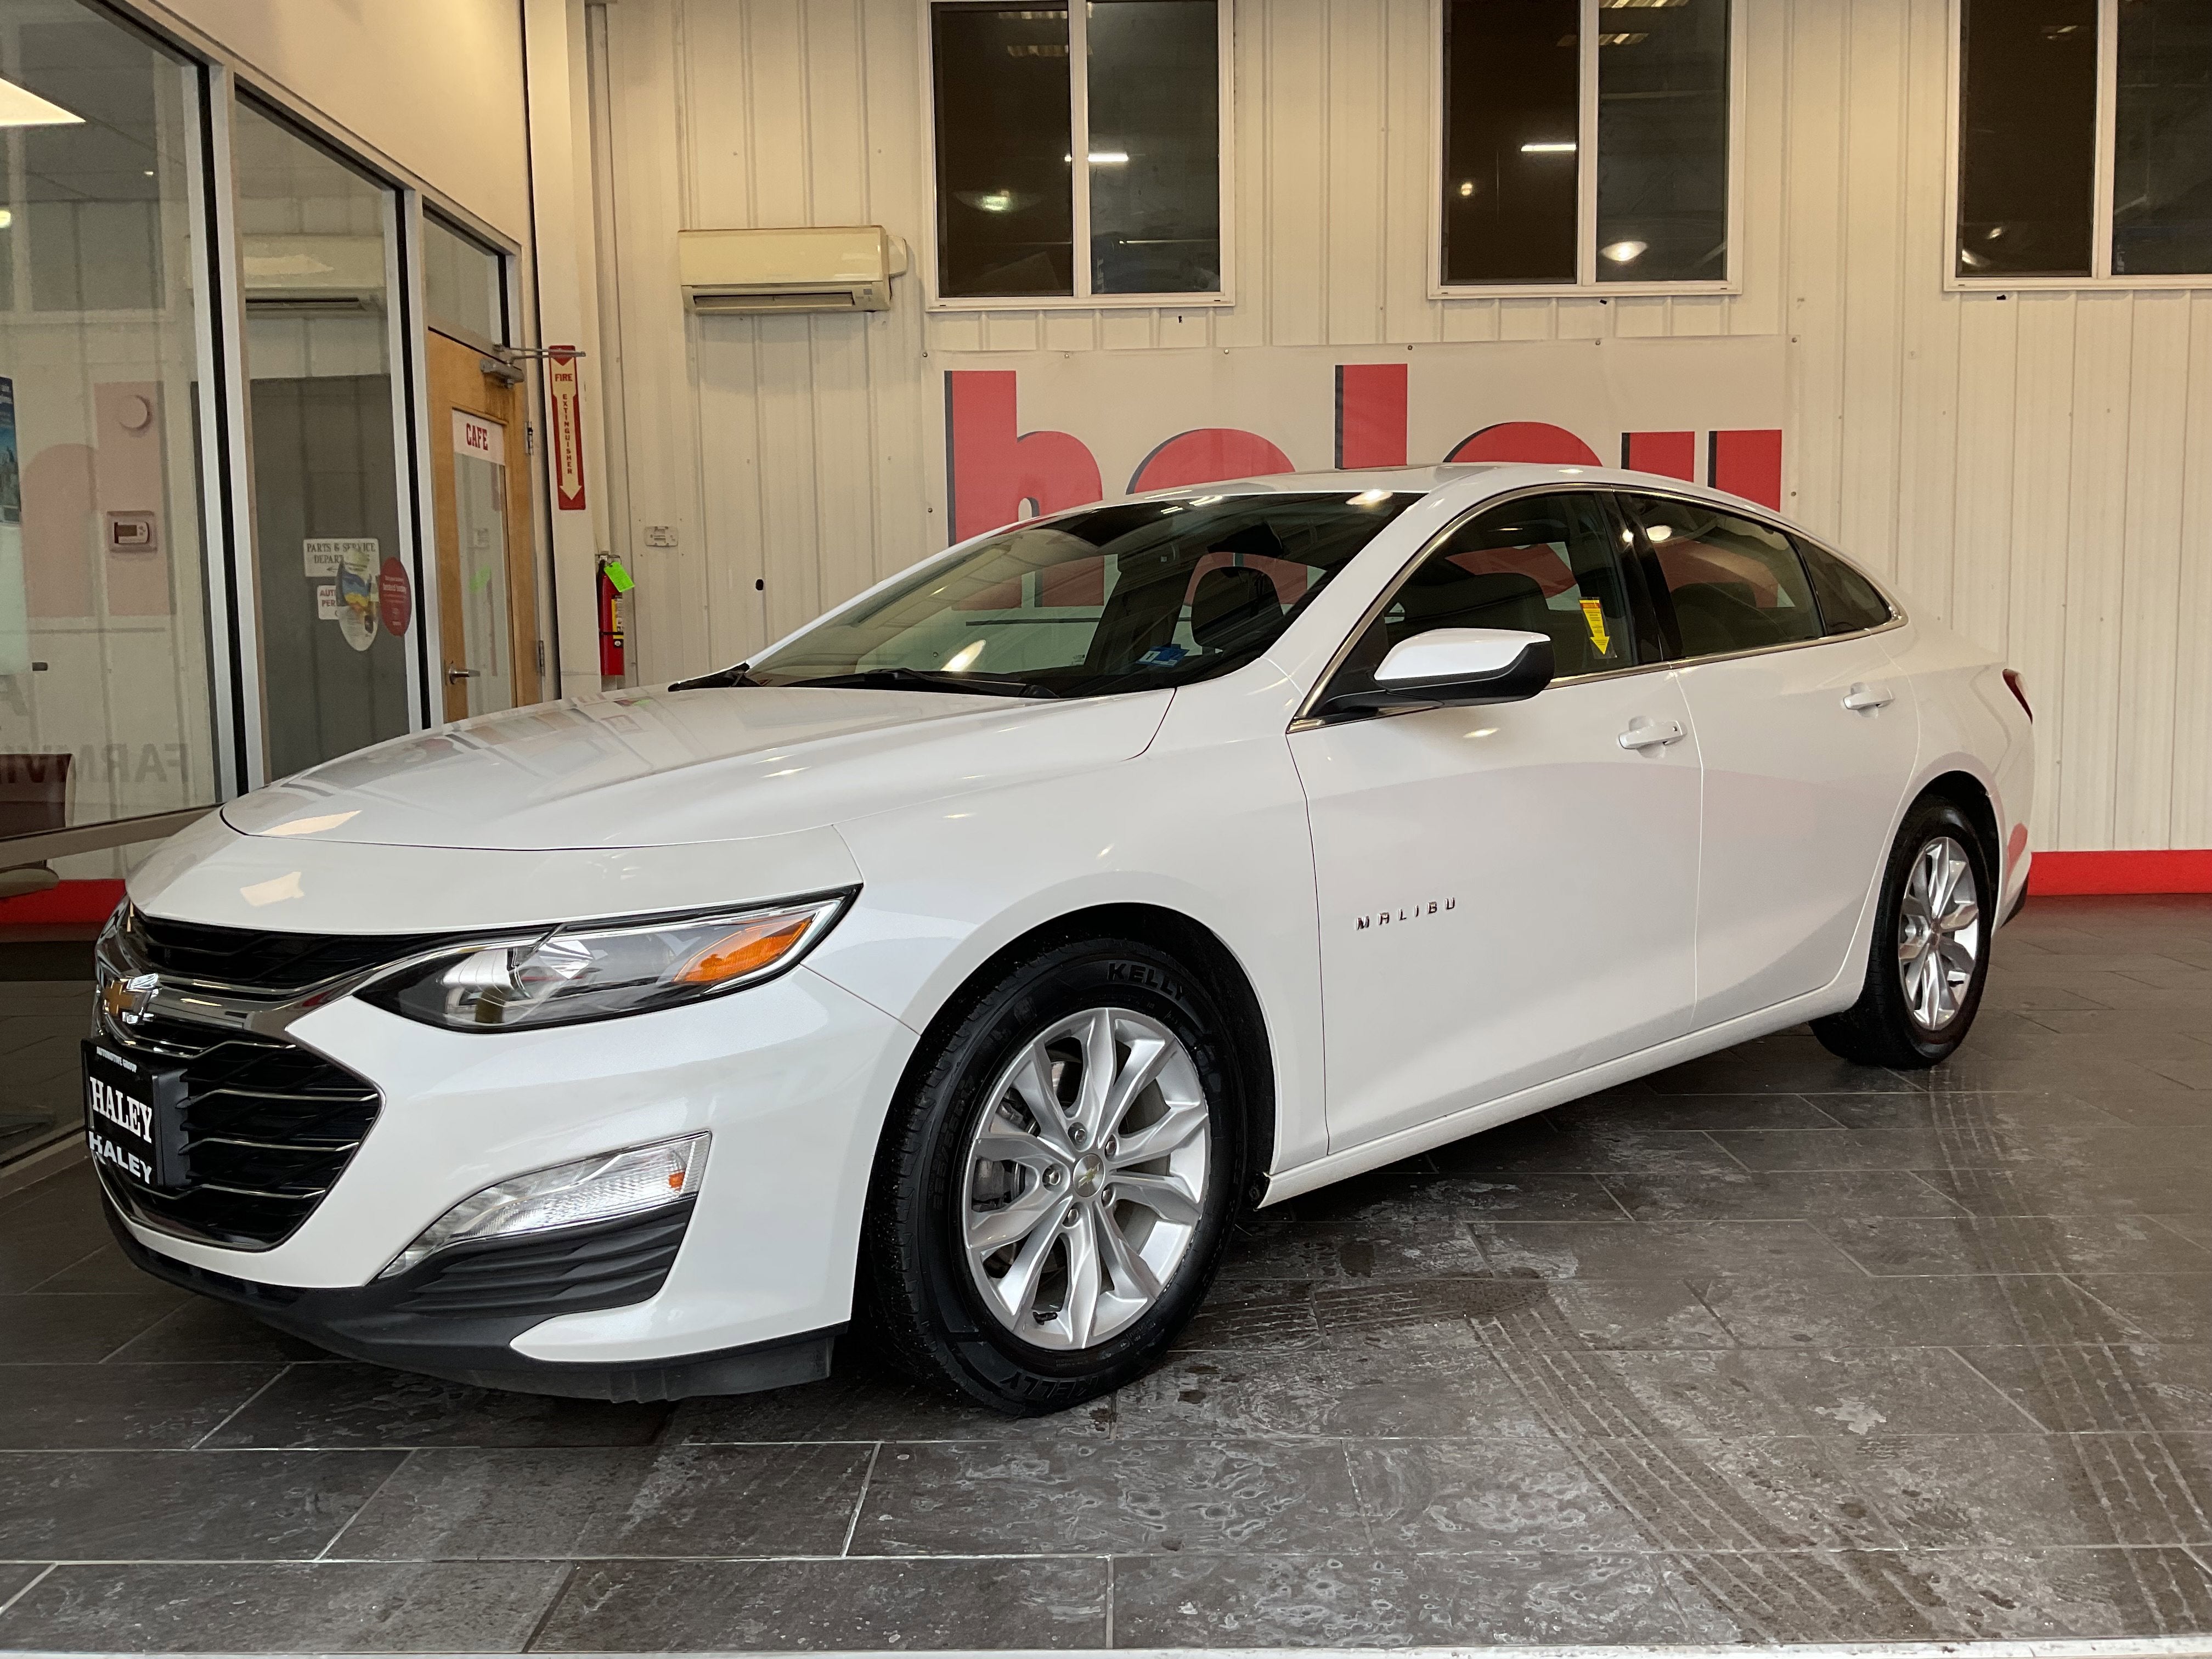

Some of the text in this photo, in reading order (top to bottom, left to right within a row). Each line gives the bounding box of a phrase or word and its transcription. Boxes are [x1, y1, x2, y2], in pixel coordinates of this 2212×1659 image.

[555, 373, 573, 382] FIRE
[466, 422, 488, 451] CAFE
[562, 393, 572, 475] EXTINGUISHER
[307, 542, 376, 552] PARTS & SERVICE
[320, 589, 336, 597] AUT
[321, 599, 336, 607] PER
[1356, 897, 1455, 930] MALIBU
[1107, 962, 1186, 1002] KELLY
[89, 1076, 152, 1144] HALEY
[88, 1130, 152, 1184] HALEY
